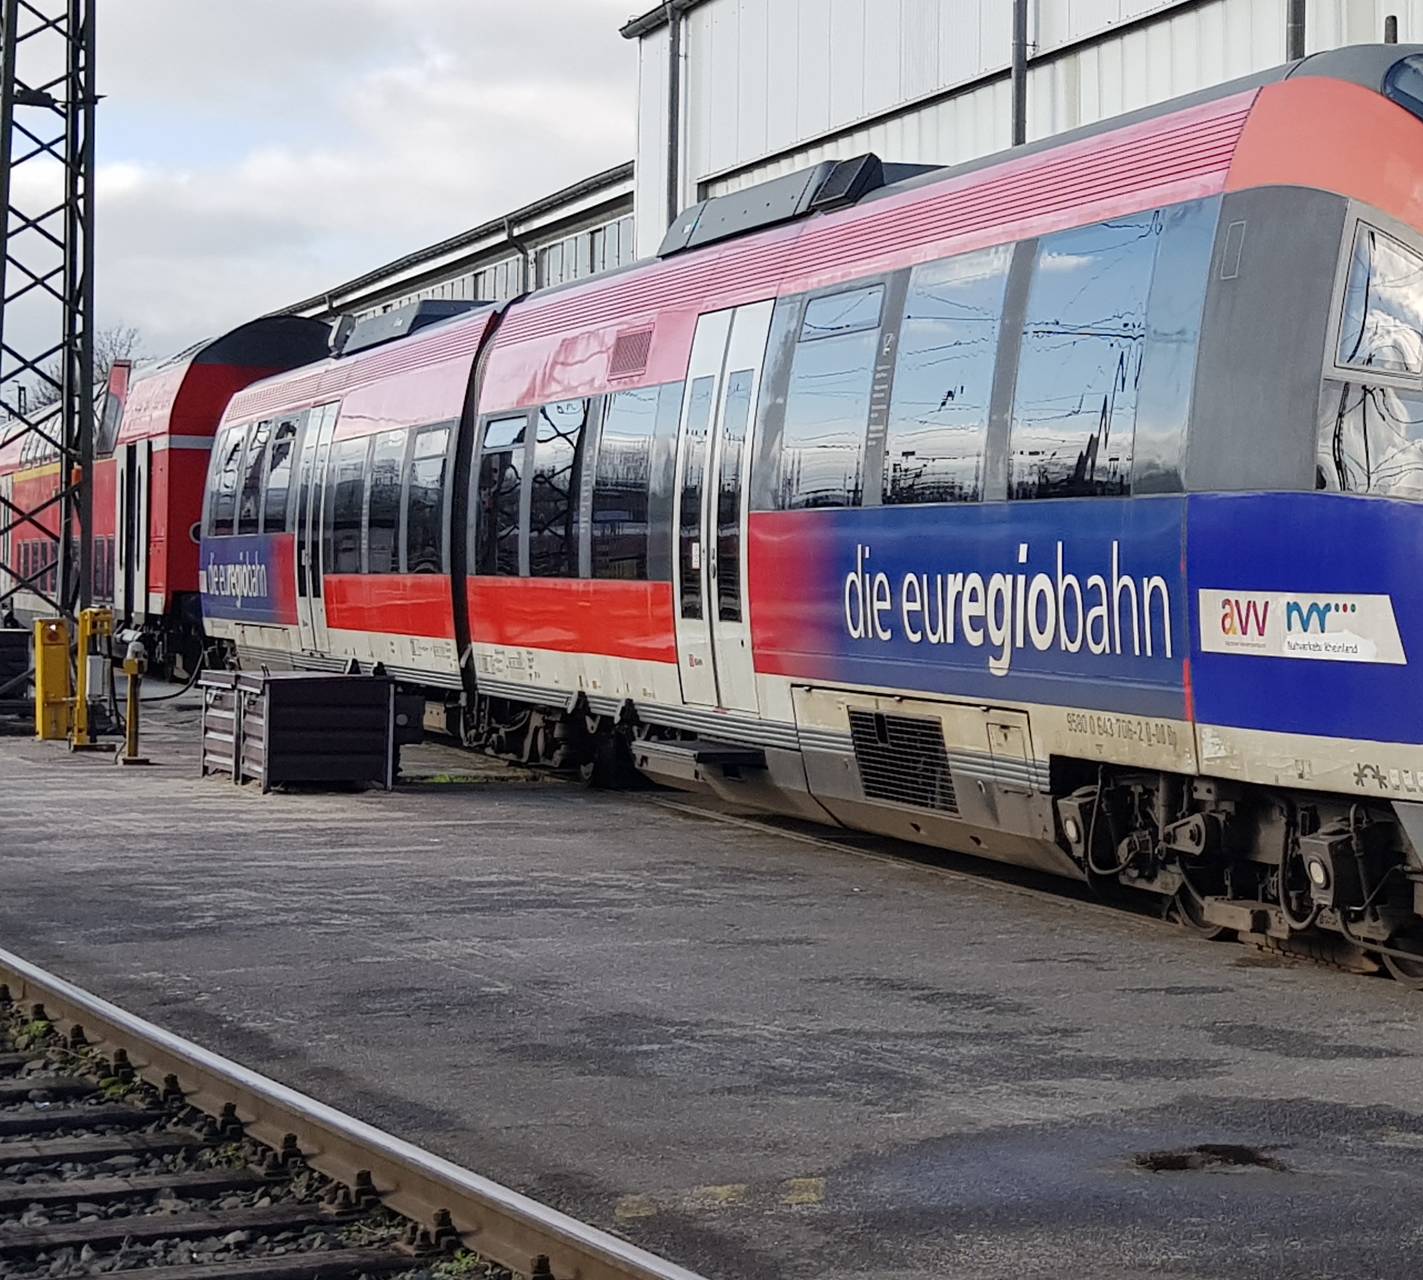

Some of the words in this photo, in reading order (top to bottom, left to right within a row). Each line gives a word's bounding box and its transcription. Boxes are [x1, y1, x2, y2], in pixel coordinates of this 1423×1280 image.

[844, 543, 892, 641] die
[902, 540, 1172, 677] euregiobahn
[1221, 598, 1270, 637] avv
